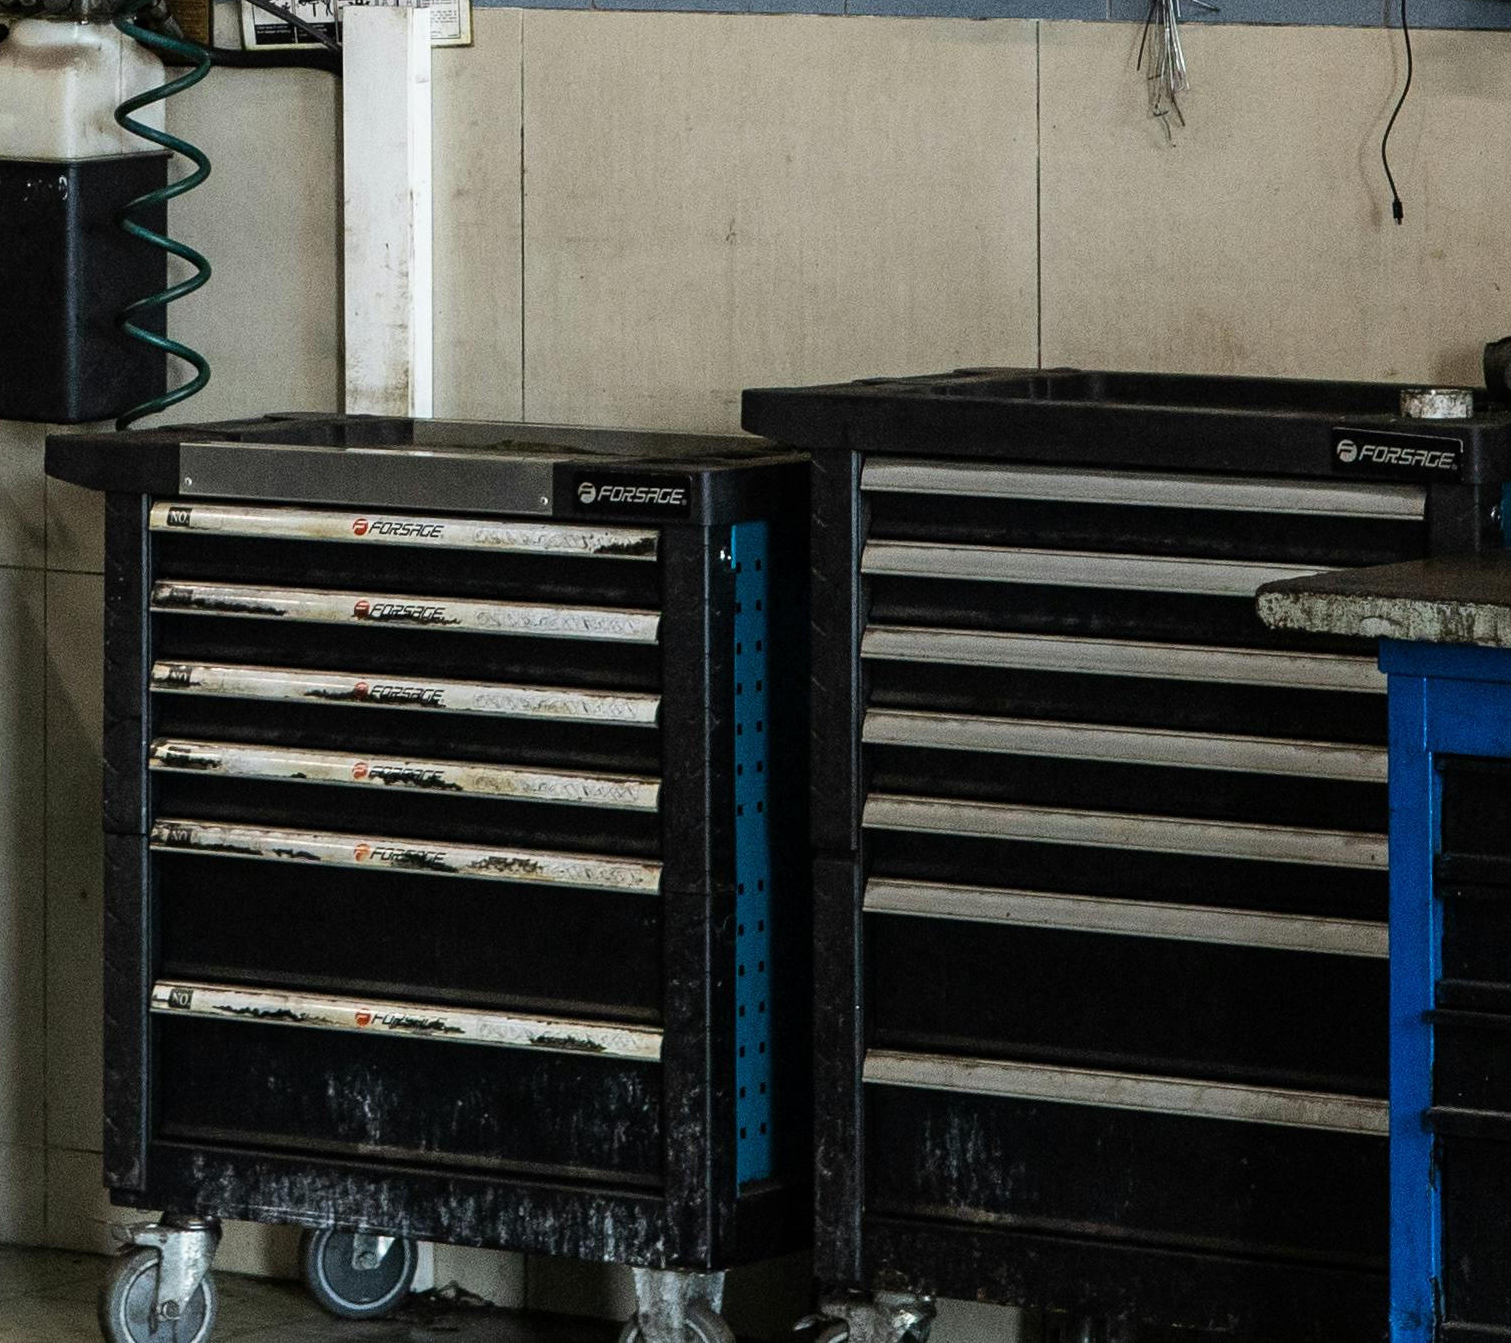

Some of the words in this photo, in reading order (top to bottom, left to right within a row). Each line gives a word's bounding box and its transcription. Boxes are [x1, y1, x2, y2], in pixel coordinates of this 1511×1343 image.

[1359, 445, 1456, 469] FORSAGE
[598, 486, 685, 504] FORSAGE
[170, 510, 189, 524] NO.
[369, 522, 444, 538] FORSAGE
[370, 604, 445, 620] FORSAGE
